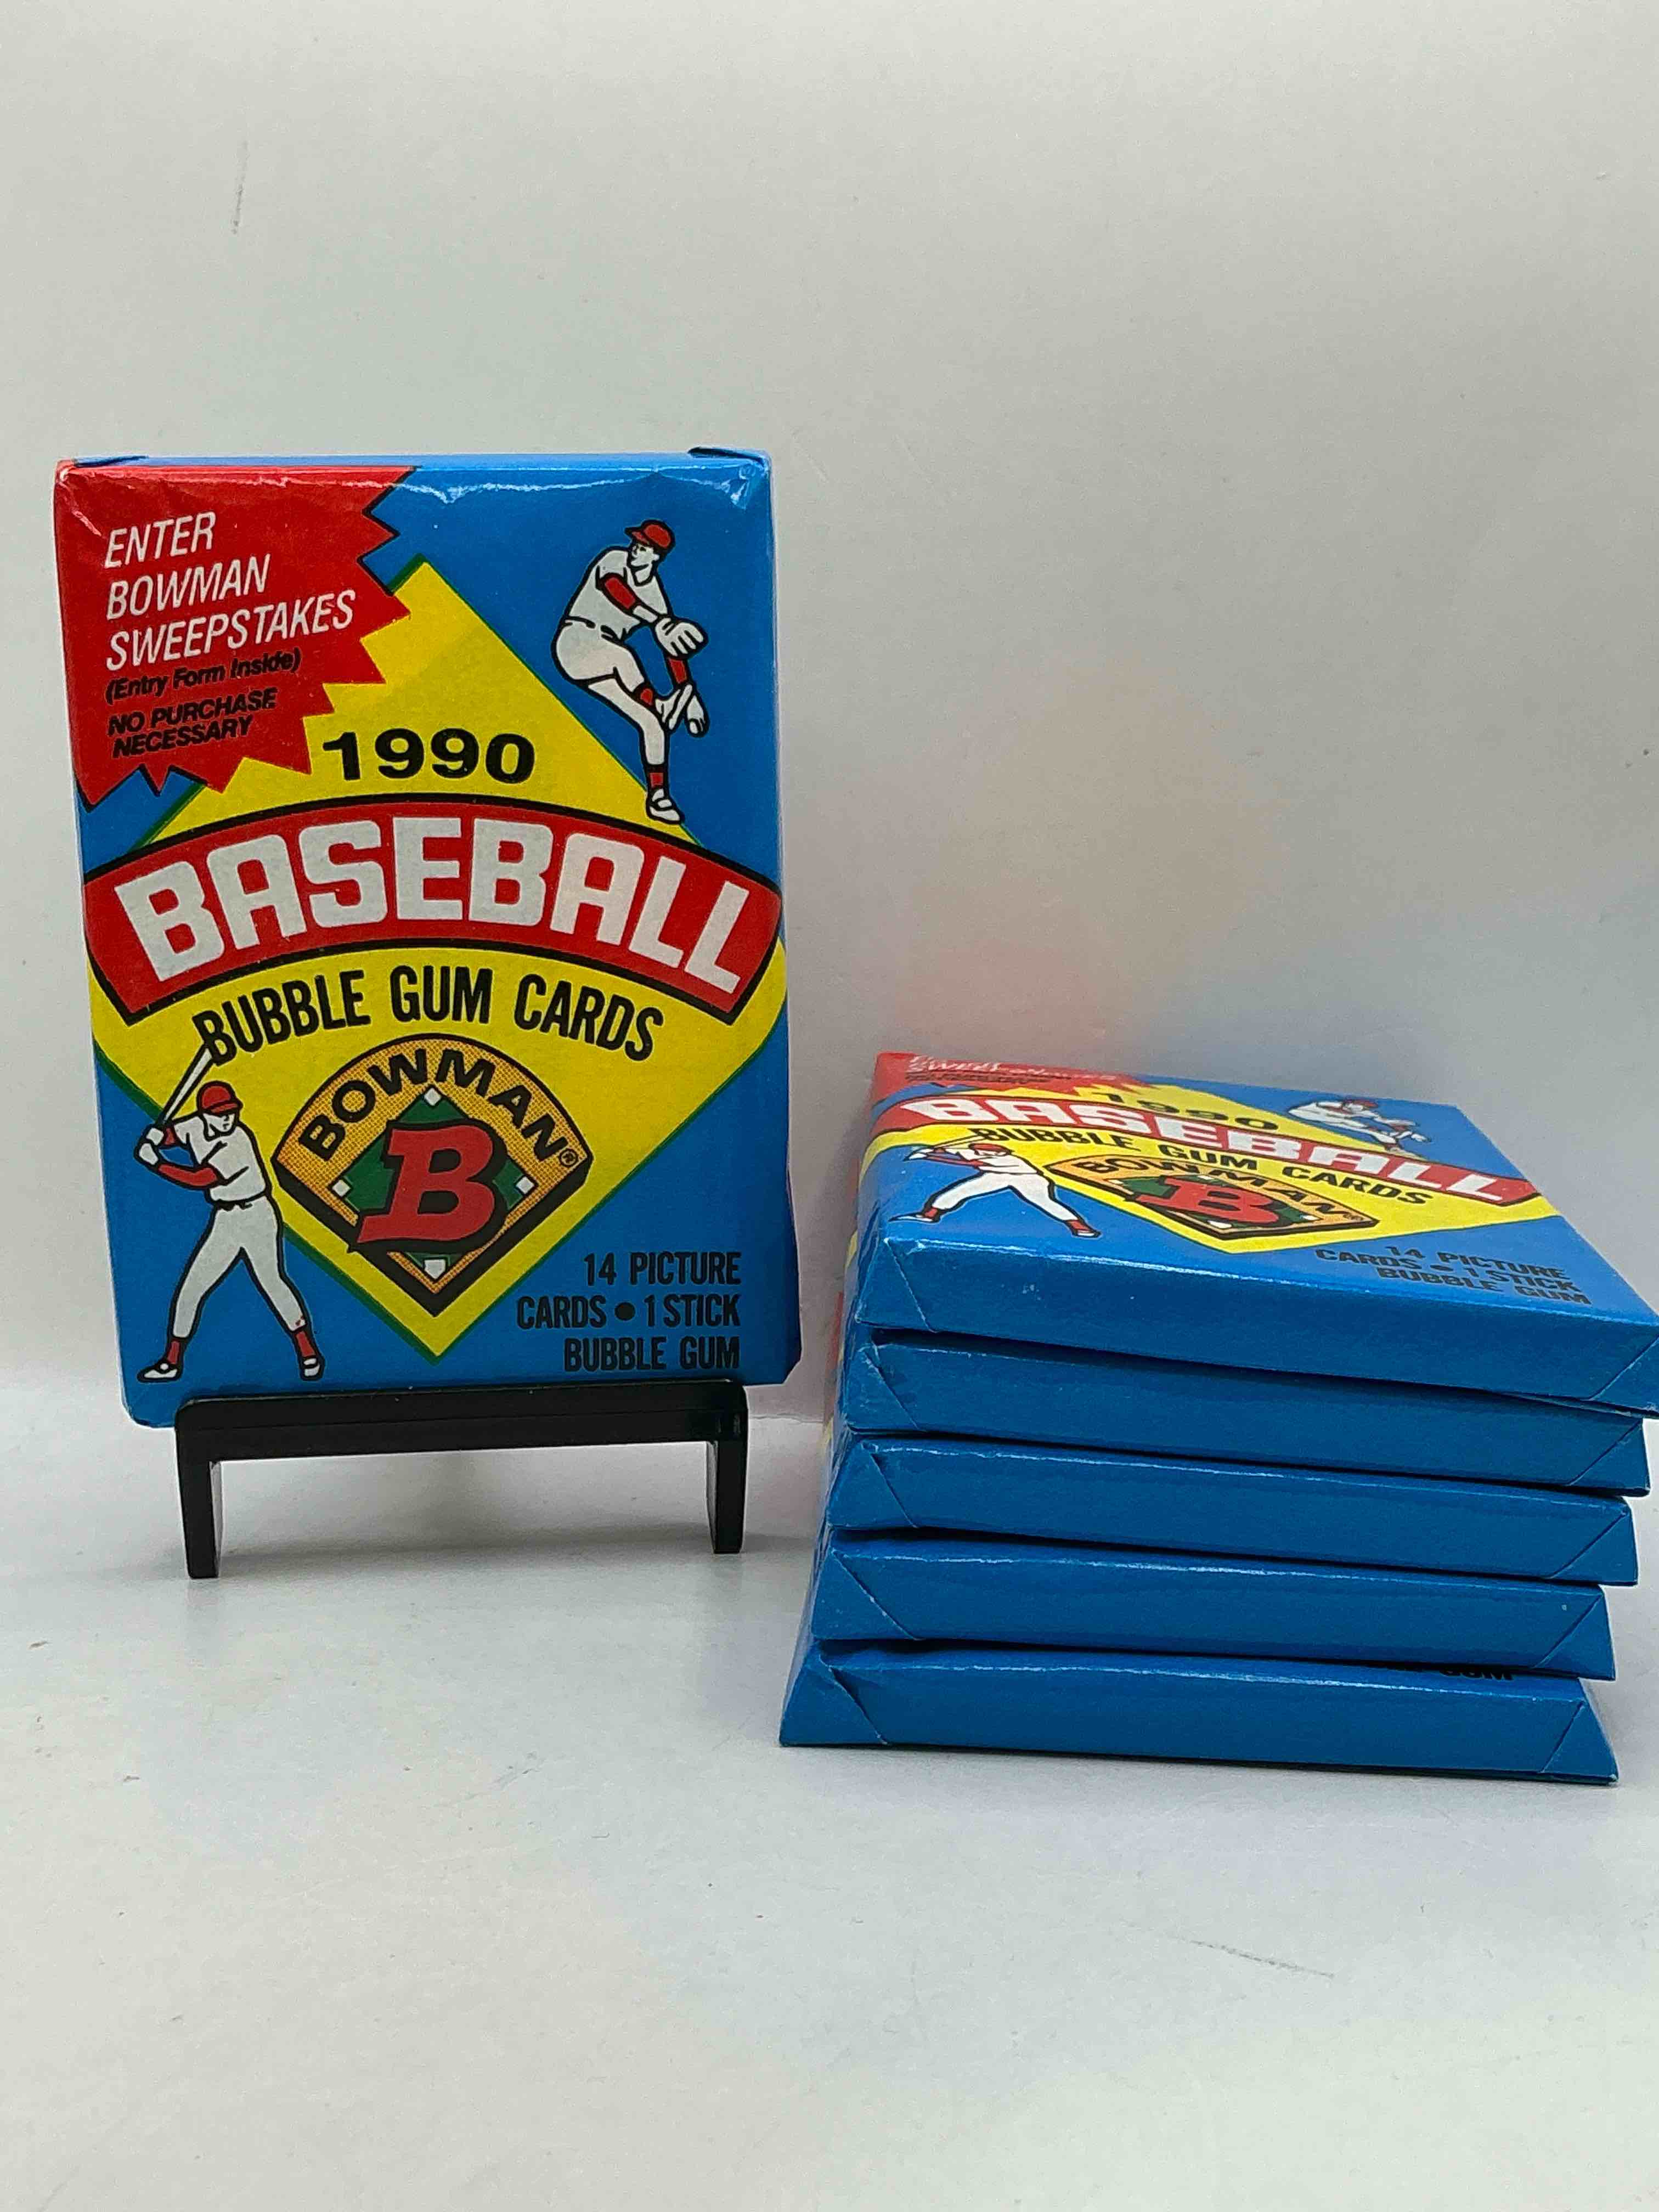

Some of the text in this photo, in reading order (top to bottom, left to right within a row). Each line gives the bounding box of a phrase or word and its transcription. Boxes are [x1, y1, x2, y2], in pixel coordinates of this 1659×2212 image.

[105, 511, 216, 568] ENTER
[106, 554, 270, 620] BOWMAN
[106, 589, 356, 671] SWEEPSTAKES
[105, 648, 301, 705] (Entry Form Inside)
[109, 687, 278, 735] NO PURCHASE
[112, 715, 253, 758] NECESSARY
[323, 728, 535, 784] 1990
[114, 817, 750, 994] BASEBALL
[193, 966, 664, 1064] BUBBLE GUM CARDS
[1097, 1092, 1278, 1130] 1990
[901, 1098, 1503, 1201] BASEBALL
[973, 1128, 1432, 1205] BUBBLE GUM CARDS
[357, 1125, 495, 1243] B
[584, 1251, 742, 1286] 14 PICTURE
[1315, 1249, 1423, 1270] CARDS
[1486, 1271, 1582, 1293] STICK
[1376, 1267, 1592, 1305] BUBBLE GUM
[1437, 1252, 1571, 1280] PICTURE
[517, 1294, 741, 1329] CARDS 1 STICK
[564, 1336, 740, 1372] BUBBLE GUM
